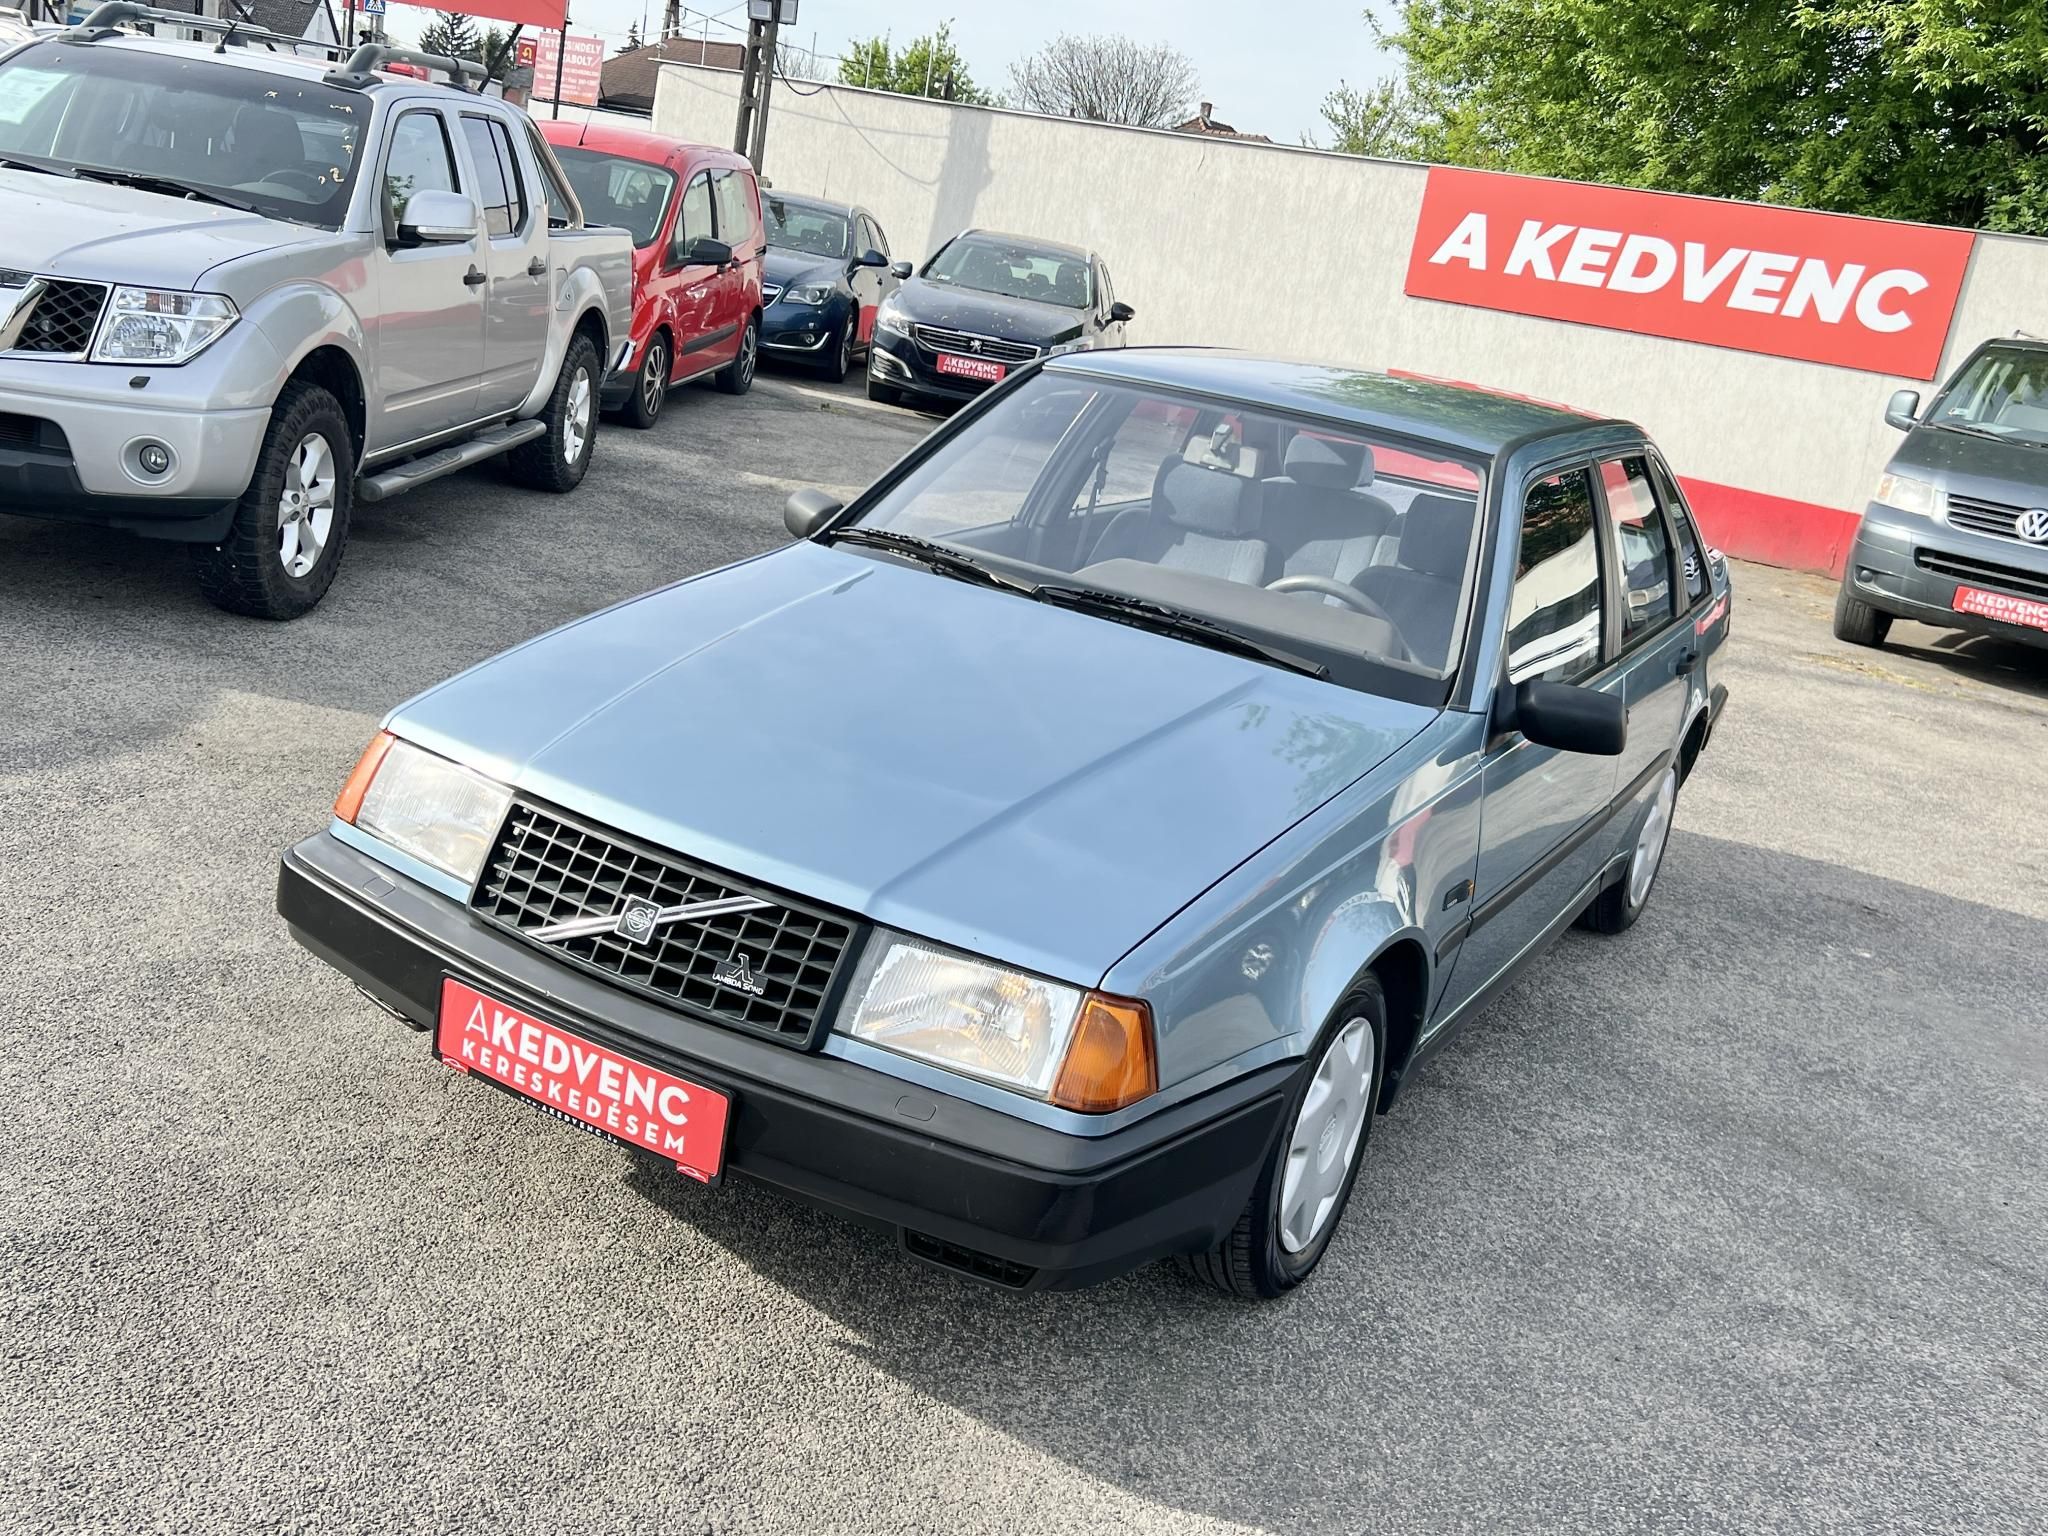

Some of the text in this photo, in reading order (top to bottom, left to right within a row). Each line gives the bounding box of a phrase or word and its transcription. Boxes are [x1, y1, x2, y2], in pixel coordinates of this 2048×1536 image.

[1428, 212, 1929, 333] A KEDVENC
[712, 973, 764, 996] LAMBDA SOND
[462, 1037, 686, 1155] KERESKEDÉSEM
